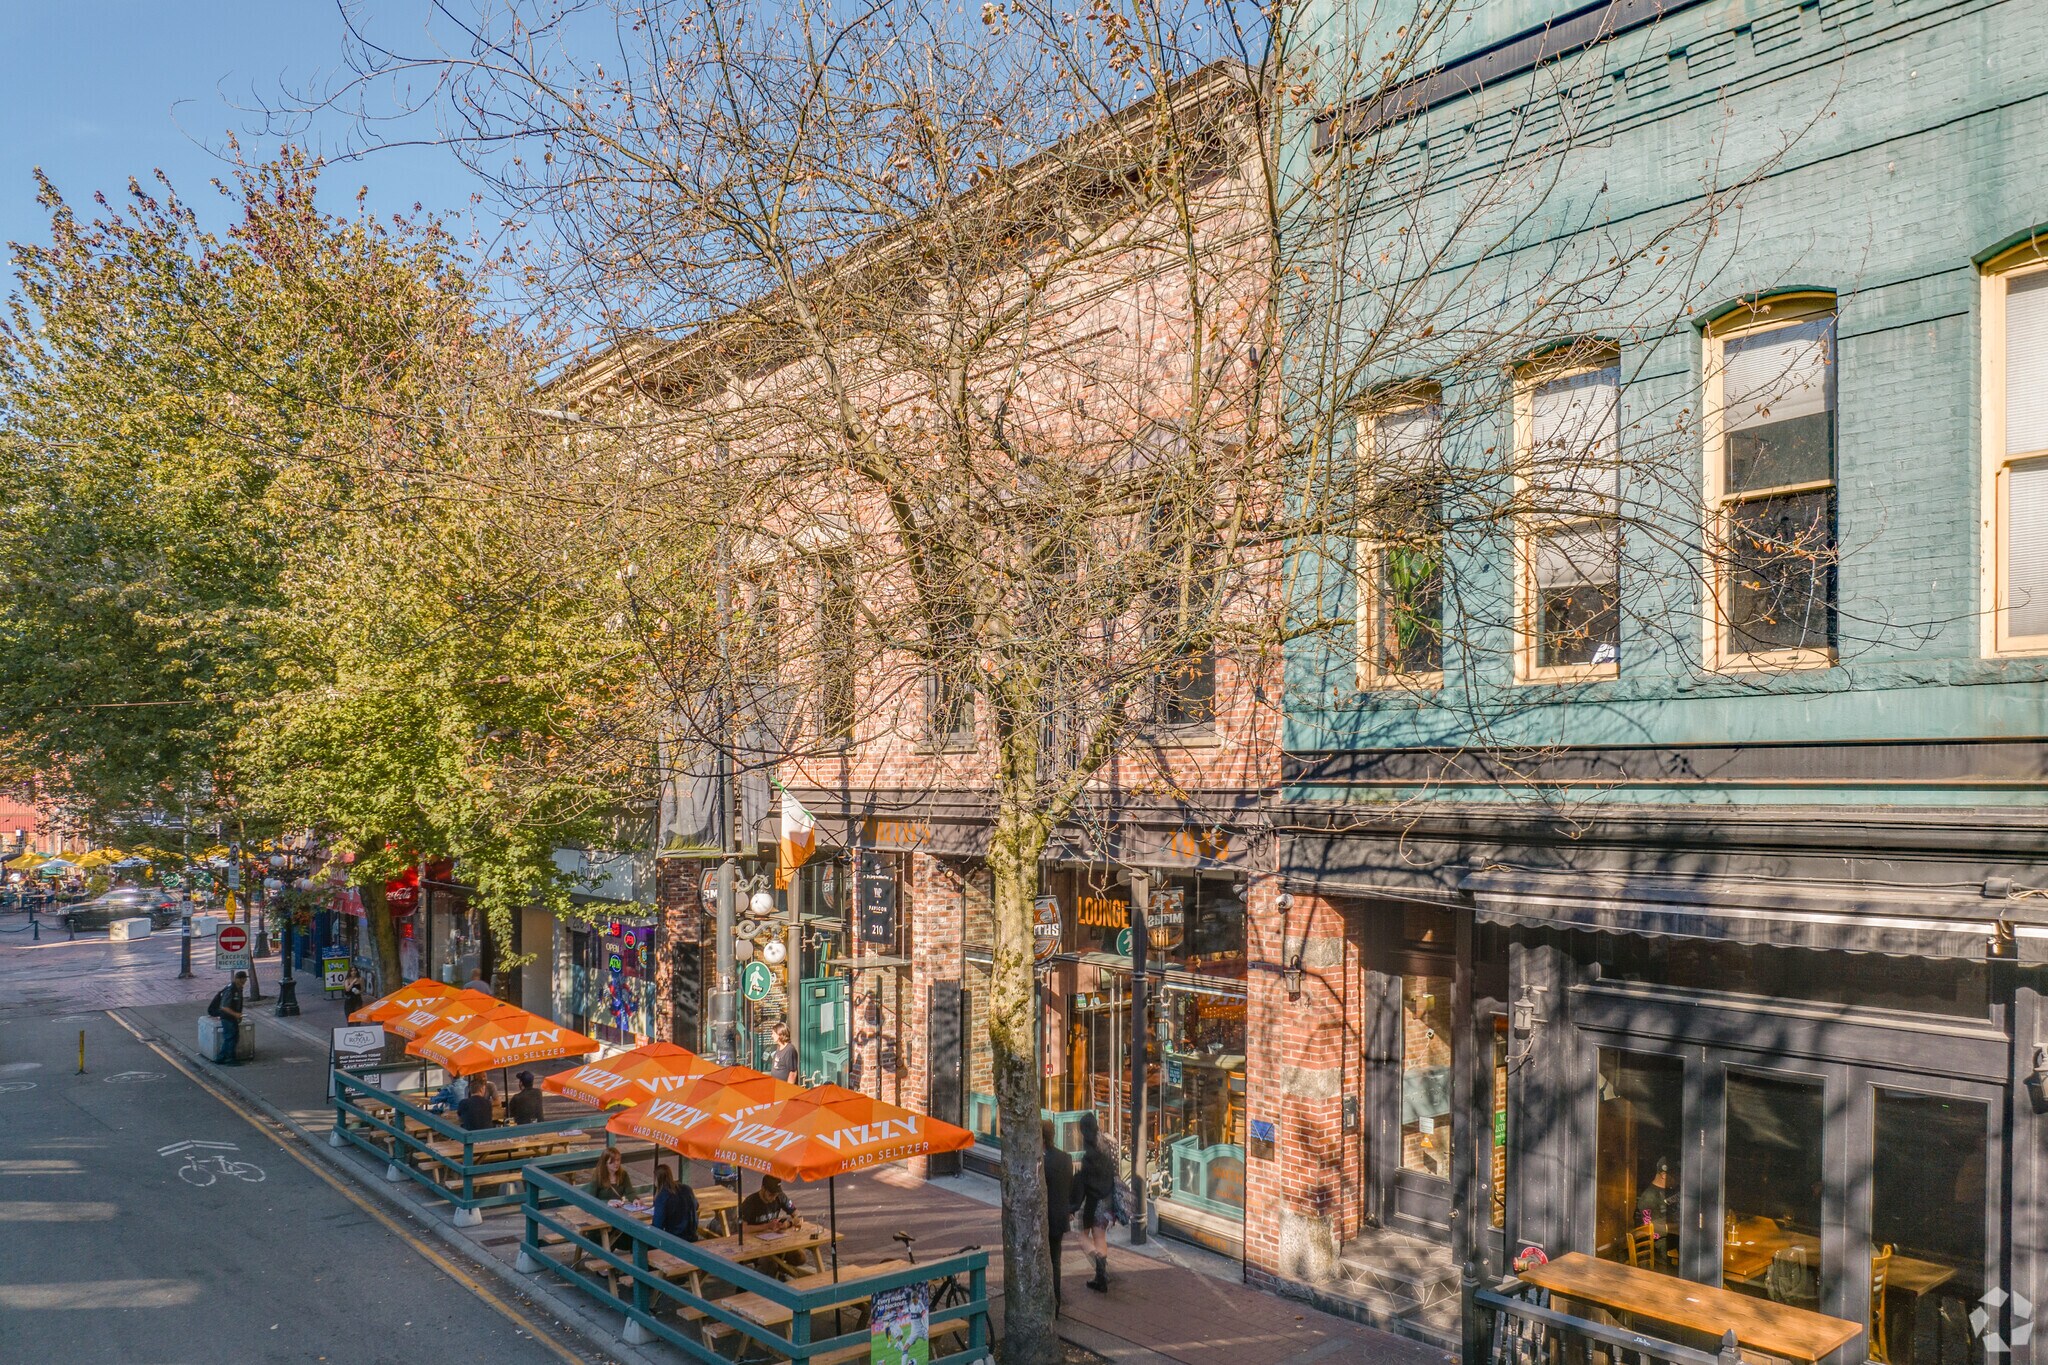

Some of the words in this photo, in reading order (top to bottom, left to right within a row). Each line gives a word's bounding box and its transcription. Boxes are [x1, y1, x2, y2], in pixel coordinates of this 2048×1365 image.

[1077, 896, 1130, 928] LOUNGE
[871, 924, 884, 935] 210
[1034, 923, 1060, 937] THS
[605, 942, 620, 953] OPEN
[609, 957, 622, 969] ATM
[330, 973, 345, 983] 10
[430, 1028, 474, 1053] VIZZY
[477, 1028, 561, 1053] VIZZY
[419, 1048, 432, 1058] HARD
[431, 1051, 449, 1065] SELTZER
[494, 1054, 520, 1066] HARD
[523, 1047, 566, 1060] SELTZER
[573, 1065, 633, 1092] VIZZY
[562, 1086, 577, 1099] HARD
[578, 1092, 601, 1106] SELTZER
[646, 1097, 713, 1130] VIZZY
[633, 1125, 651, 1137] HARD
[651, 1131, 680, 1147] SELTZER
[727, 1120, 805, 1152] VIZZY
[815, 1115, 920, 1150] VIZZY
[714, 1148, 738, 1163] HARD
[738, 1153, 773, 1172] SELTZER
[841, 1153, 874, 1170] HARD
[878, 1141, 930, 1161] SELTZER
